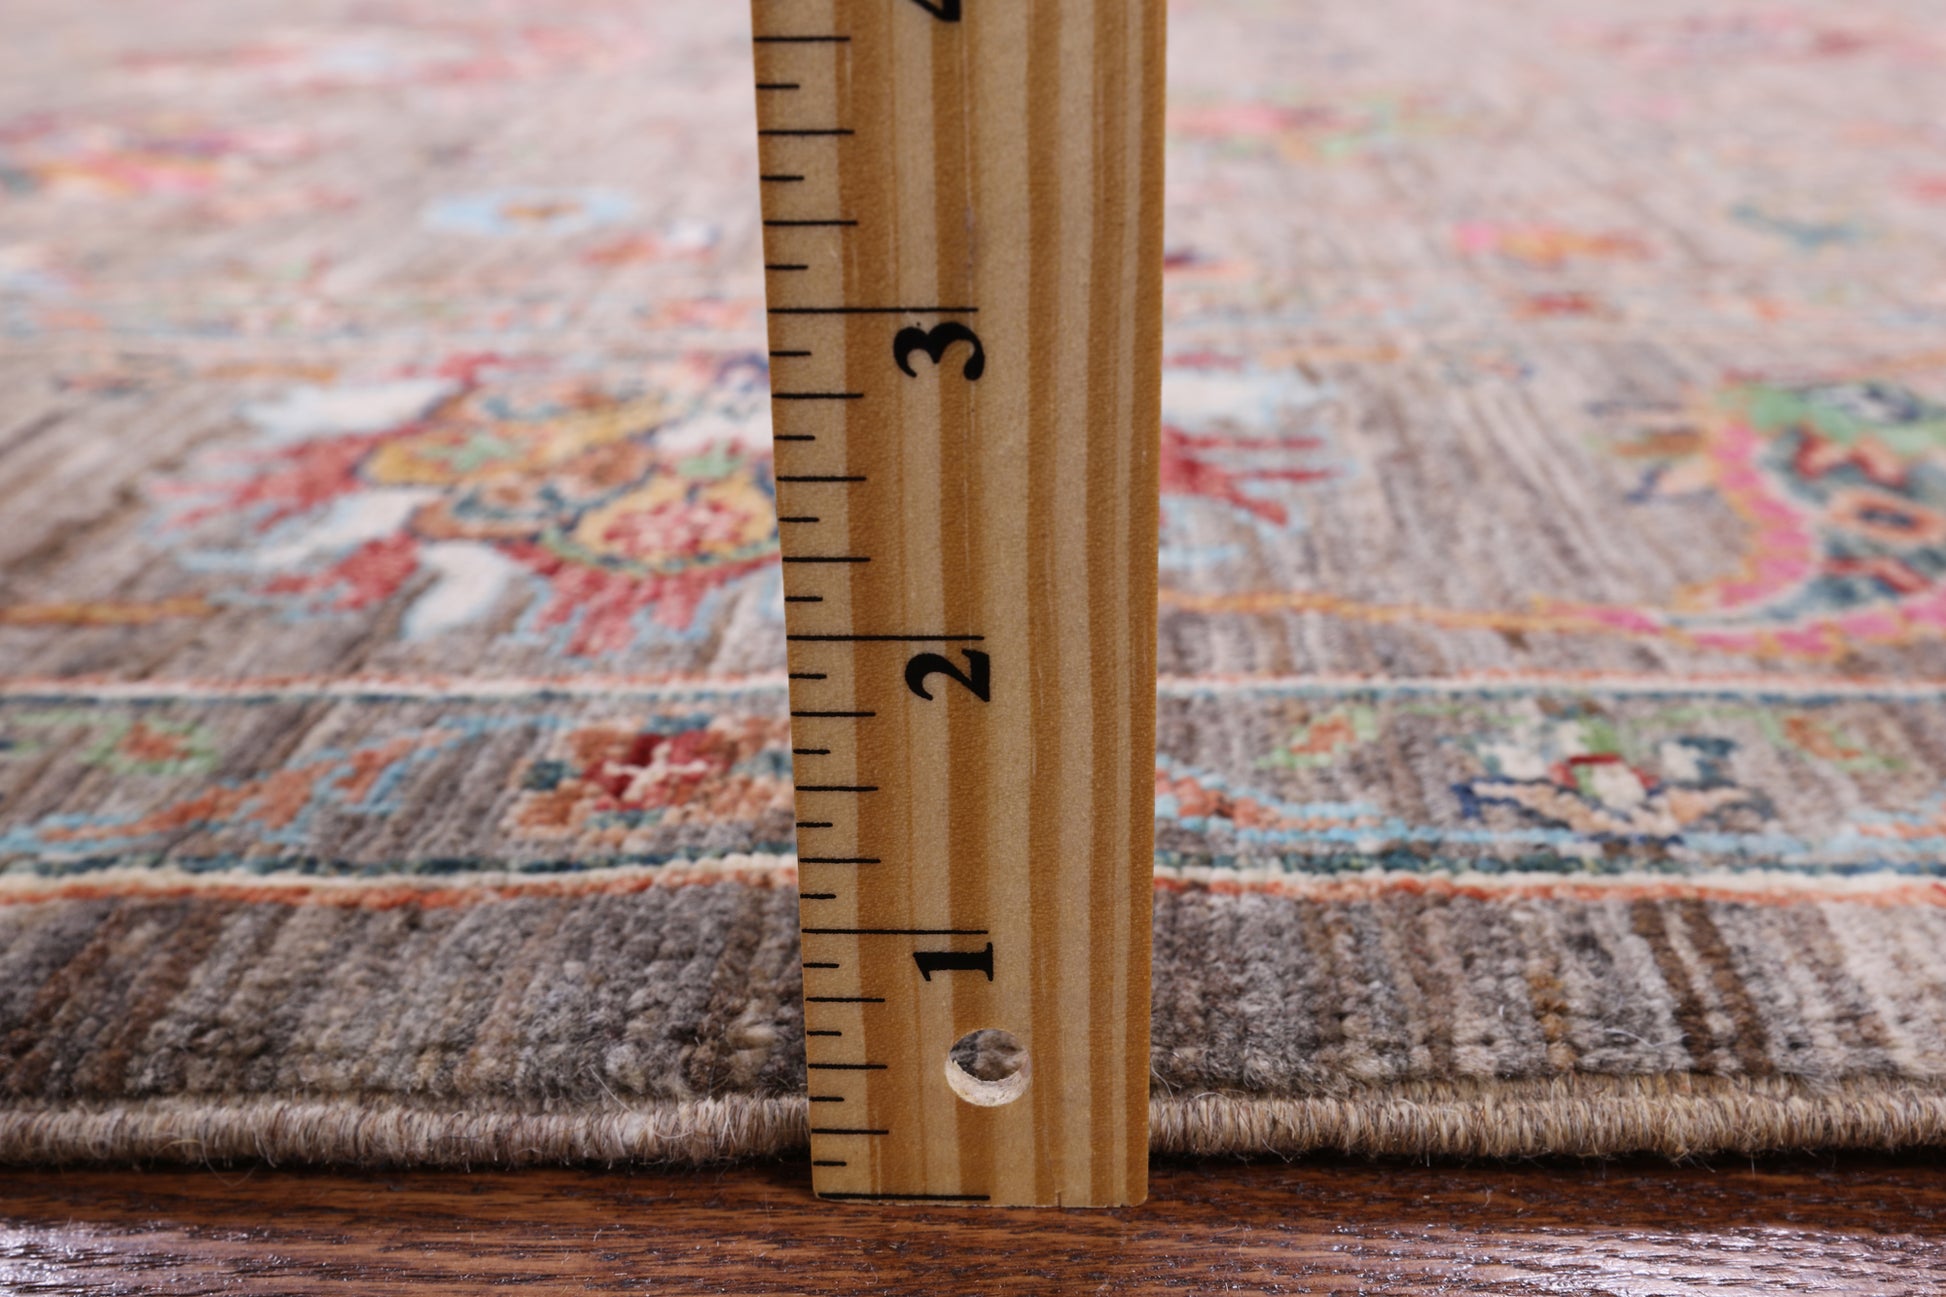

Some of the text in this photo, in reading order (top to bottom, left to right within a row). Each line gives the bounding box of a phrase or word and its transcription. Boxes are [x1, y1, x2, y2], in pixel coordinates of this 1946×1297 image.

[893, 322, 985, 381] 3
[905, 648, 990, 702] 2
[912, 942, 994, 982] 1
